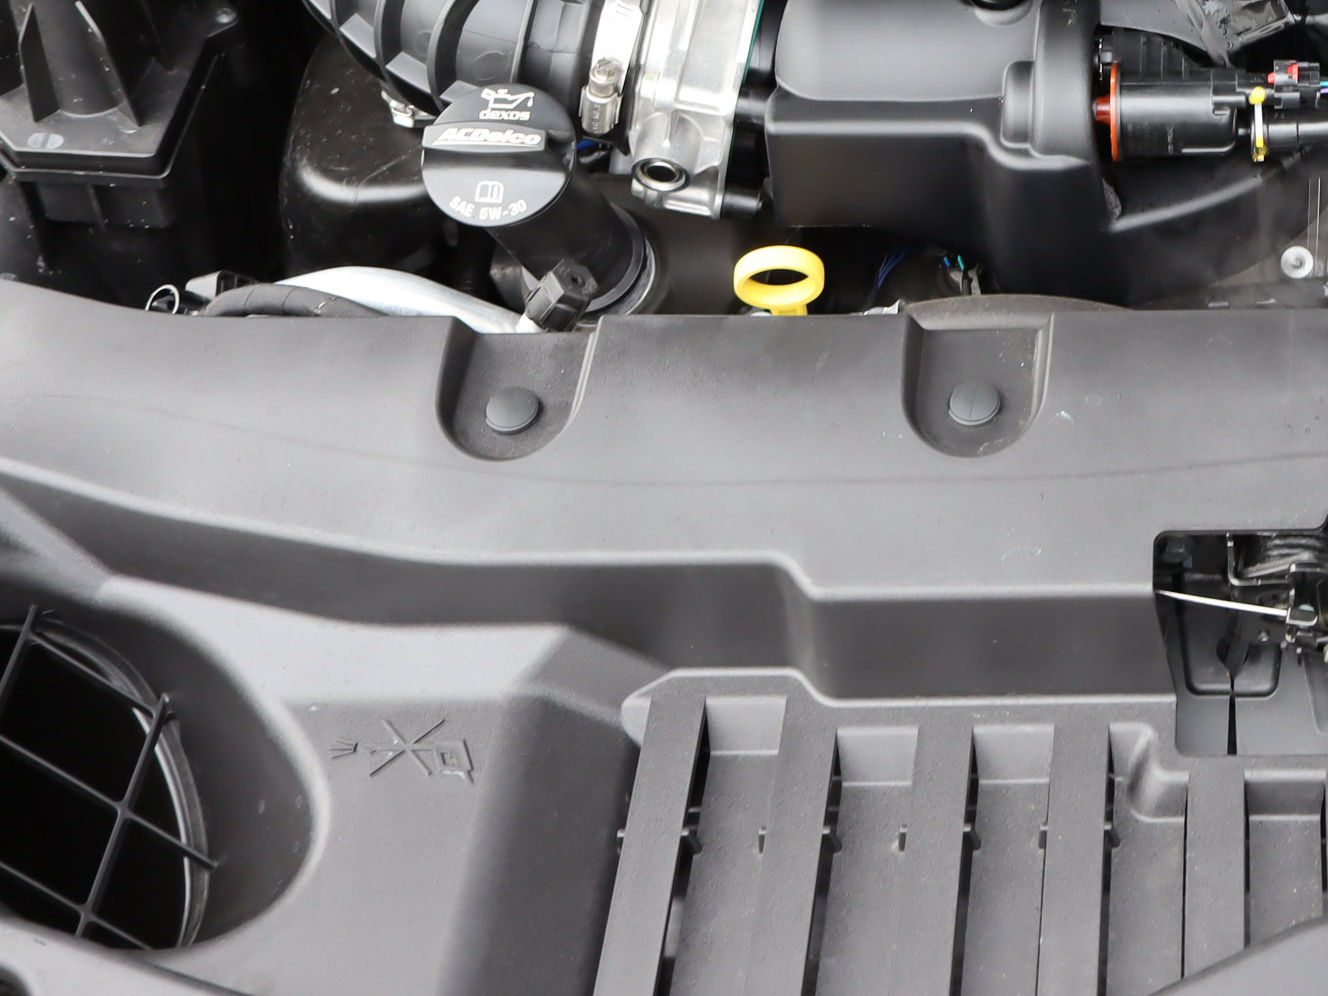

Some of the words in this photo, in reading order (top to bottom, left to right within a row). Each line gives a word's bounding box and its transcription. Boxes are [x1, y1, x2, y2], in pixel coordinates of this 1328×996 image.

[479, 108, 530, 121] dexos
[432, 127, 542, 147] ACDelco
[449, 195, 475, 217] SAE
[478, 199, 528, 221] 5W-30
